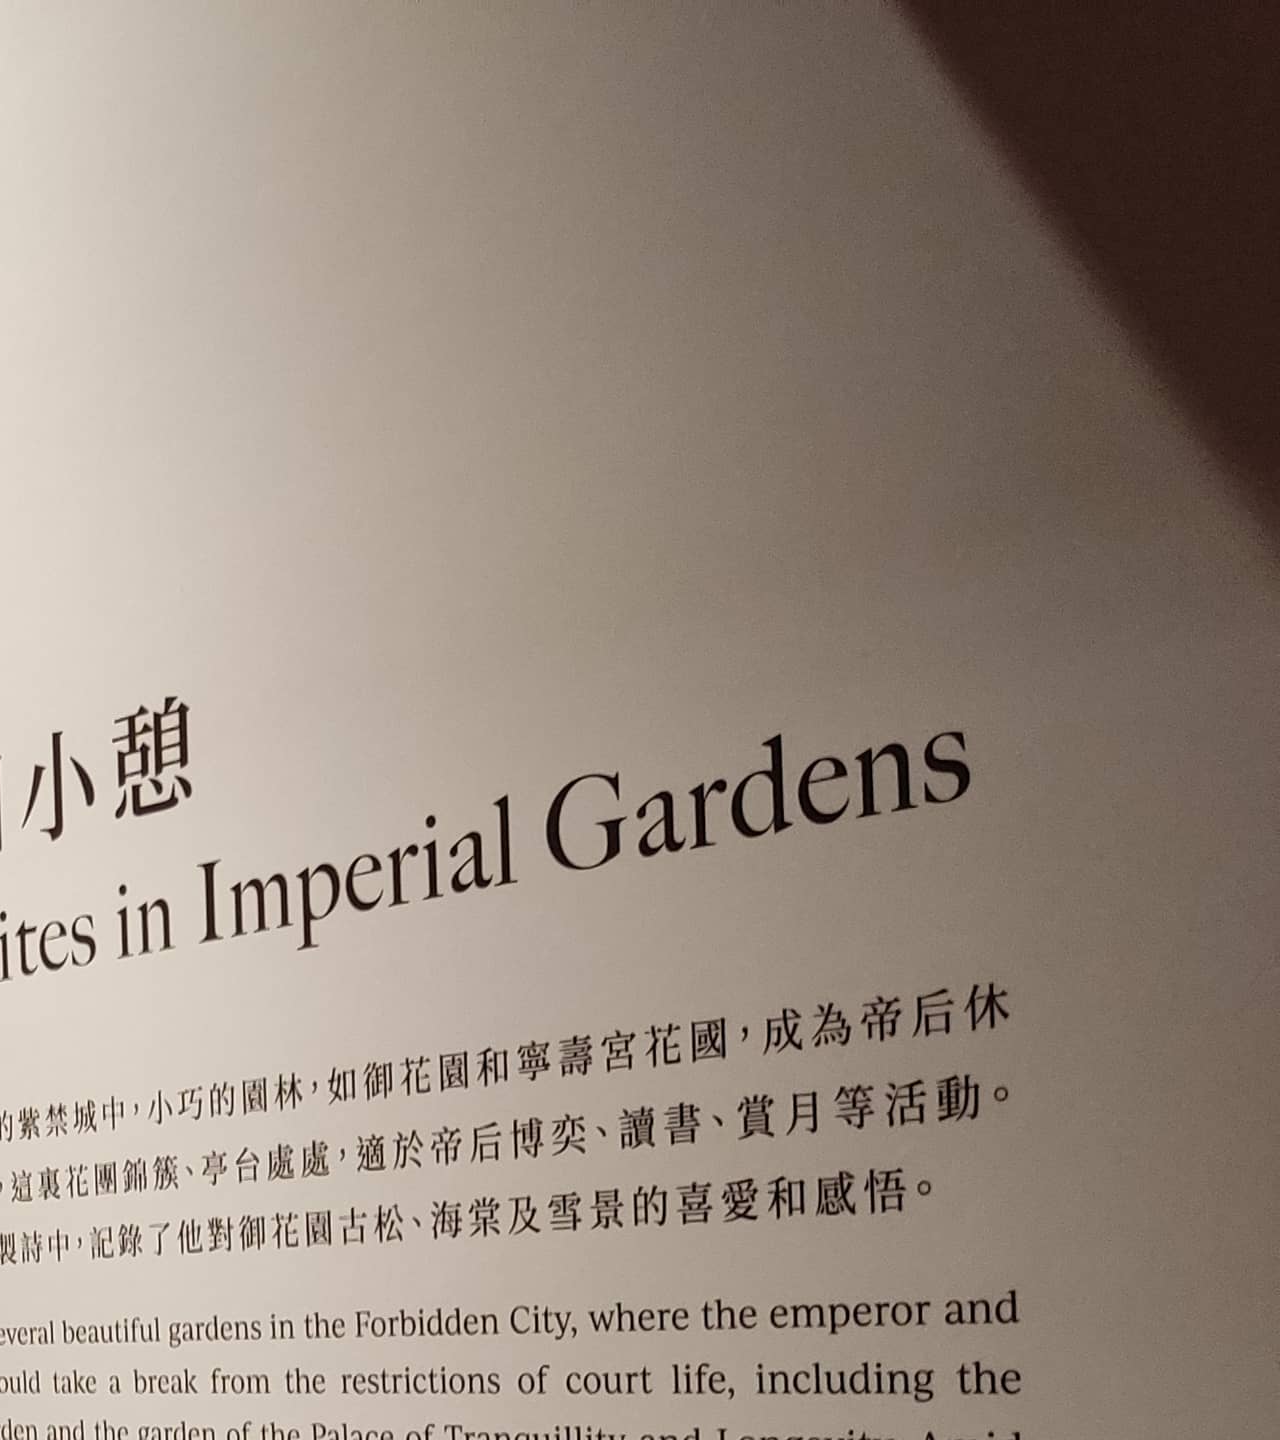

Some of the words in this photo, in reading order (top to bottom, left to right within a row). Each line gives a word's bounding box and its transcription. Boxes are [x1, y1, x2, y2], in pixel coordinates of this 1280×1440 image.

[117, 883, 174, 960] in
[197, 795, 518, 951] Imperial
[546, 727, 971, 871] Gardens
[62, 1316, 161, 1345] beautiful
[169, 1314, 262, 1349] gardens
[270, 1313, 295, 1340] in
[304, 1311, 345, 1340] the
[355, 1307, 499, 1338] Forbidden
[510, 1304, 578, 1341] City,
[588, 1301, 689, 1332] where
[701, 1298, 757, 1331] the
[769, 1301, 931, 1335] emperor
[944, 1289, 1020, 1326] and
[53, 1369, 97, 1395] take
[109, 1375, 121, 1395] a
[133, 1367, 198, 1395] break
[211, 1367, 271, 1395] from
[285, 1367, 326, 1395] the
[341, 1365, 501, 1395] restrictions
[517, 1364, 550, 1395] of
[566, 1366, 653, 1396] court
[671, 1362, 735, 1400] life,
[756, 1361, 934, 1403] including
[956, 1360, 1021, 1395] the
